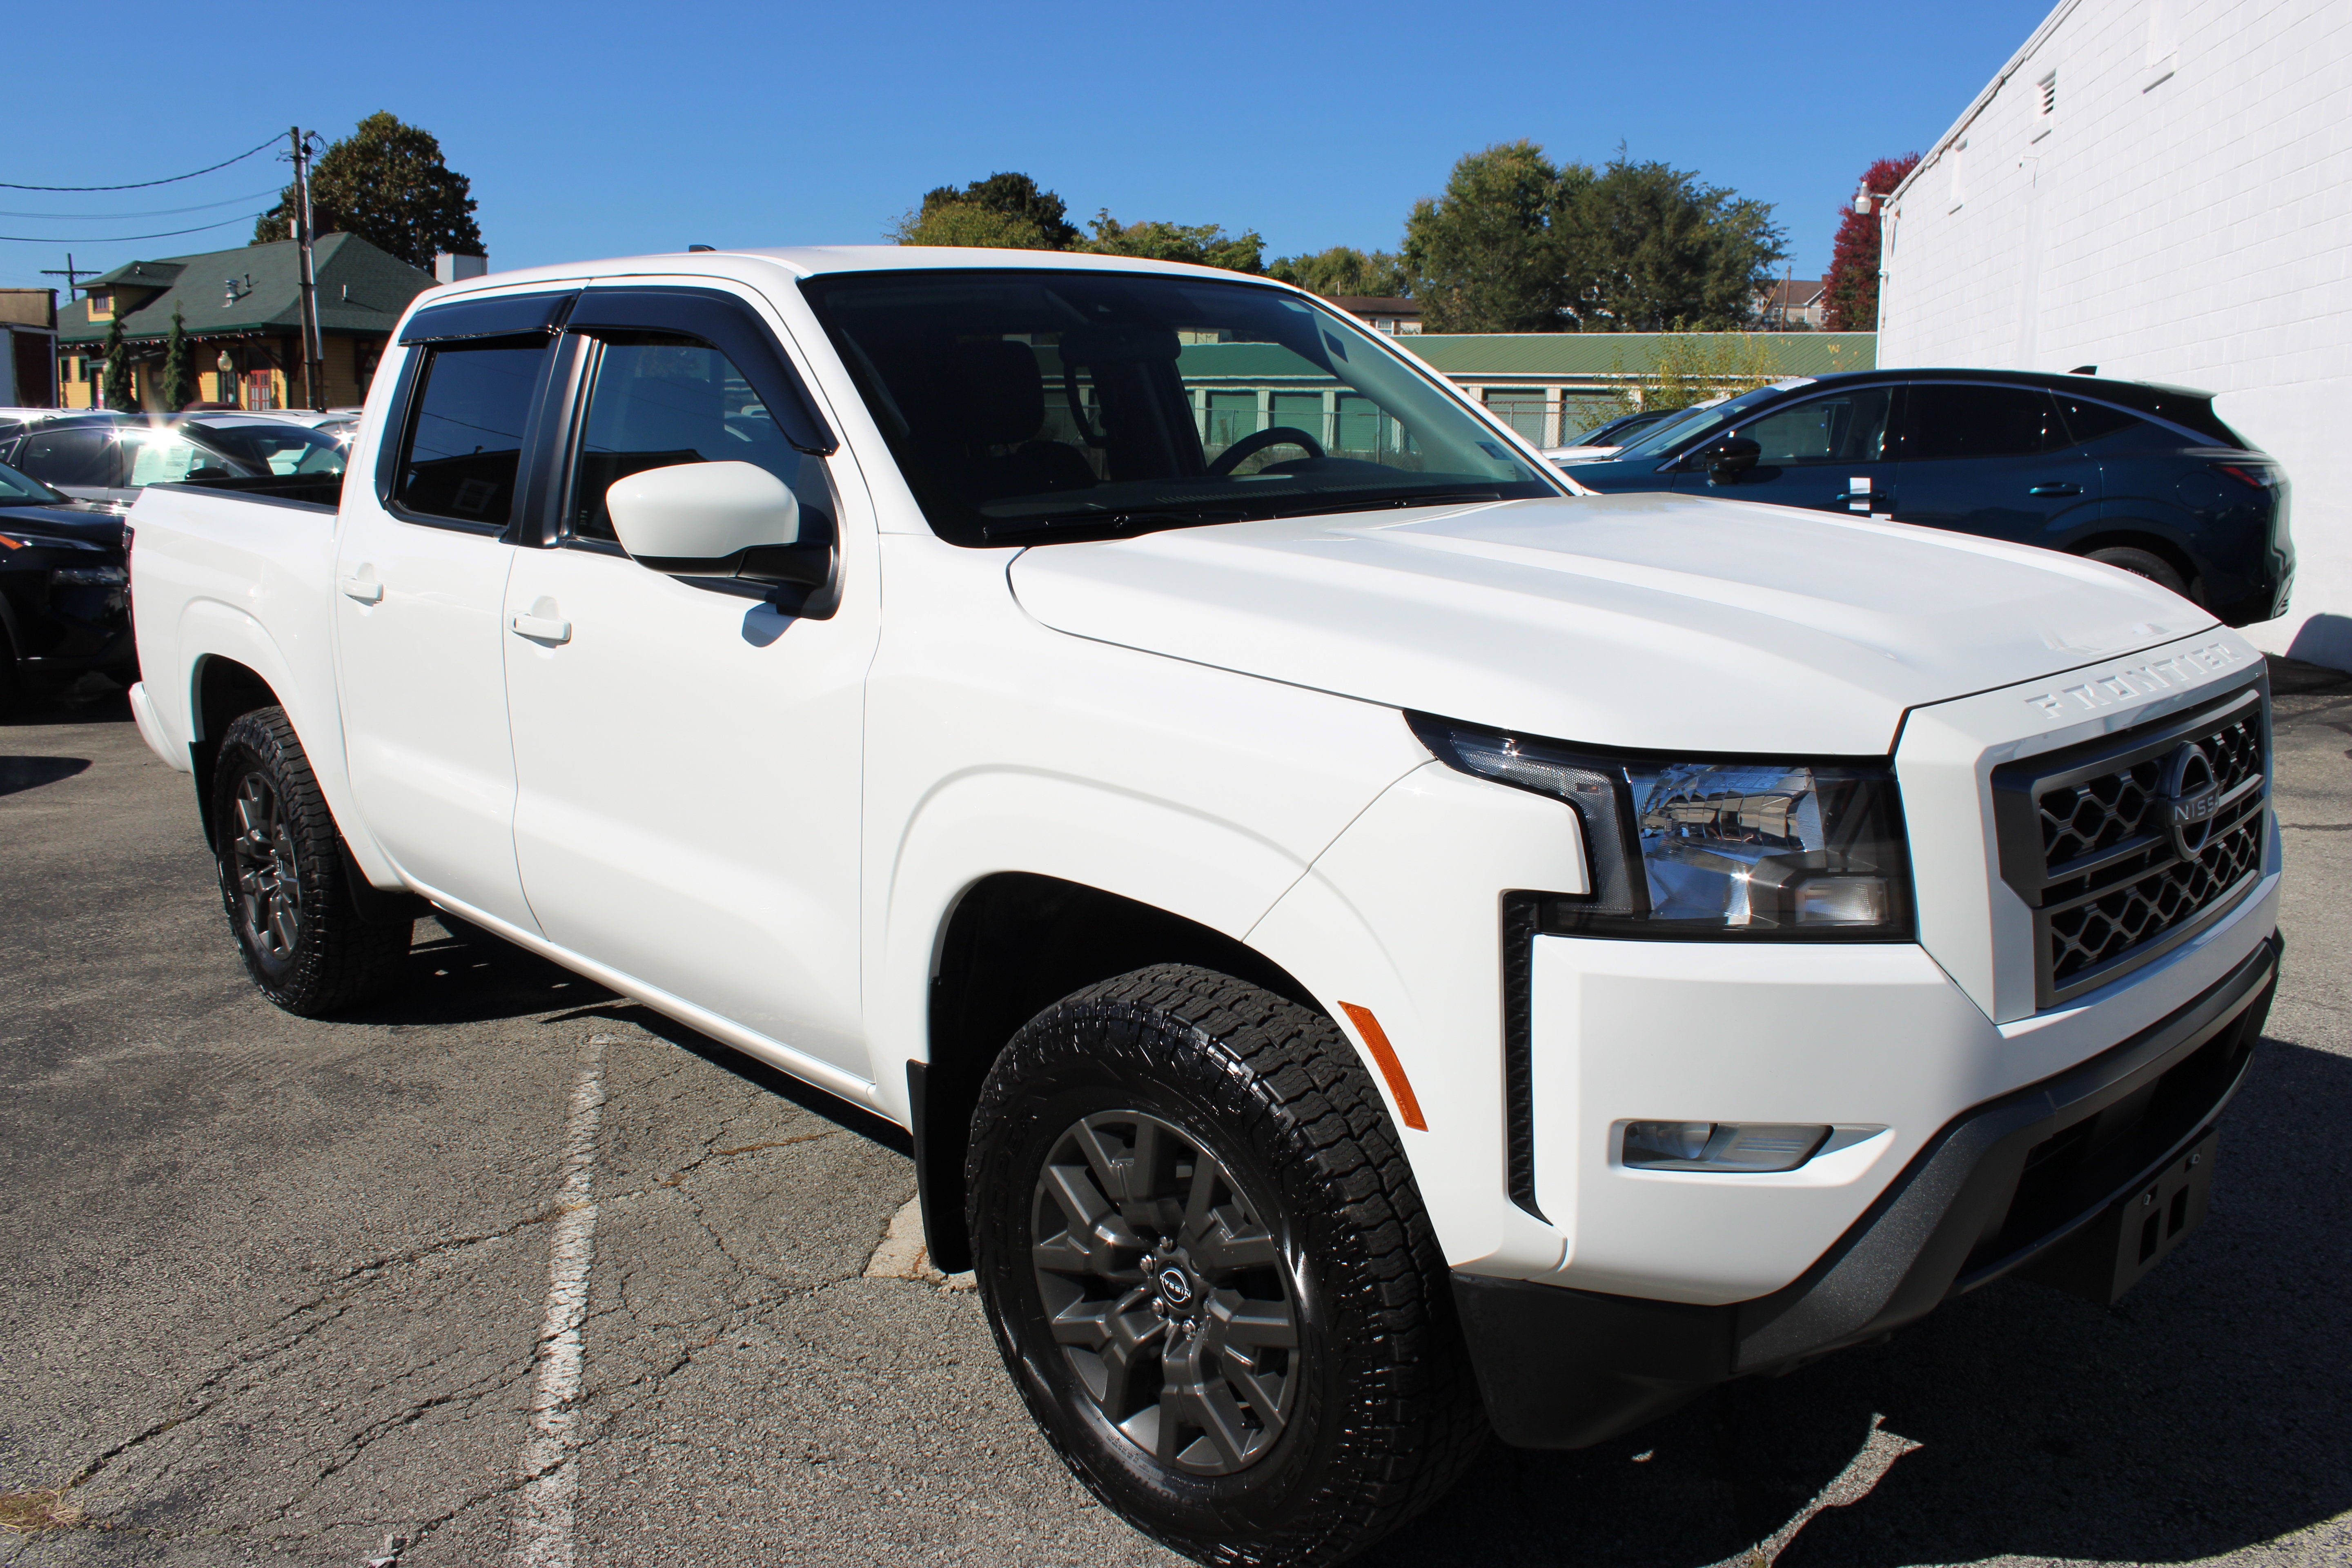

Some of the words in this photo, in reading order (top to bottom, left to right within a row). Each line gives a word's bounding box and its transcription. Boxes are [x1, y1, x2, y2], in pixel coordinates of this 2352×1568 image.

[2024, 643, 2241, 719] FRONTIER
[2174, 796, 2218, 820] NISS
[1159, 1274, 1191, 1298] NISSAN
